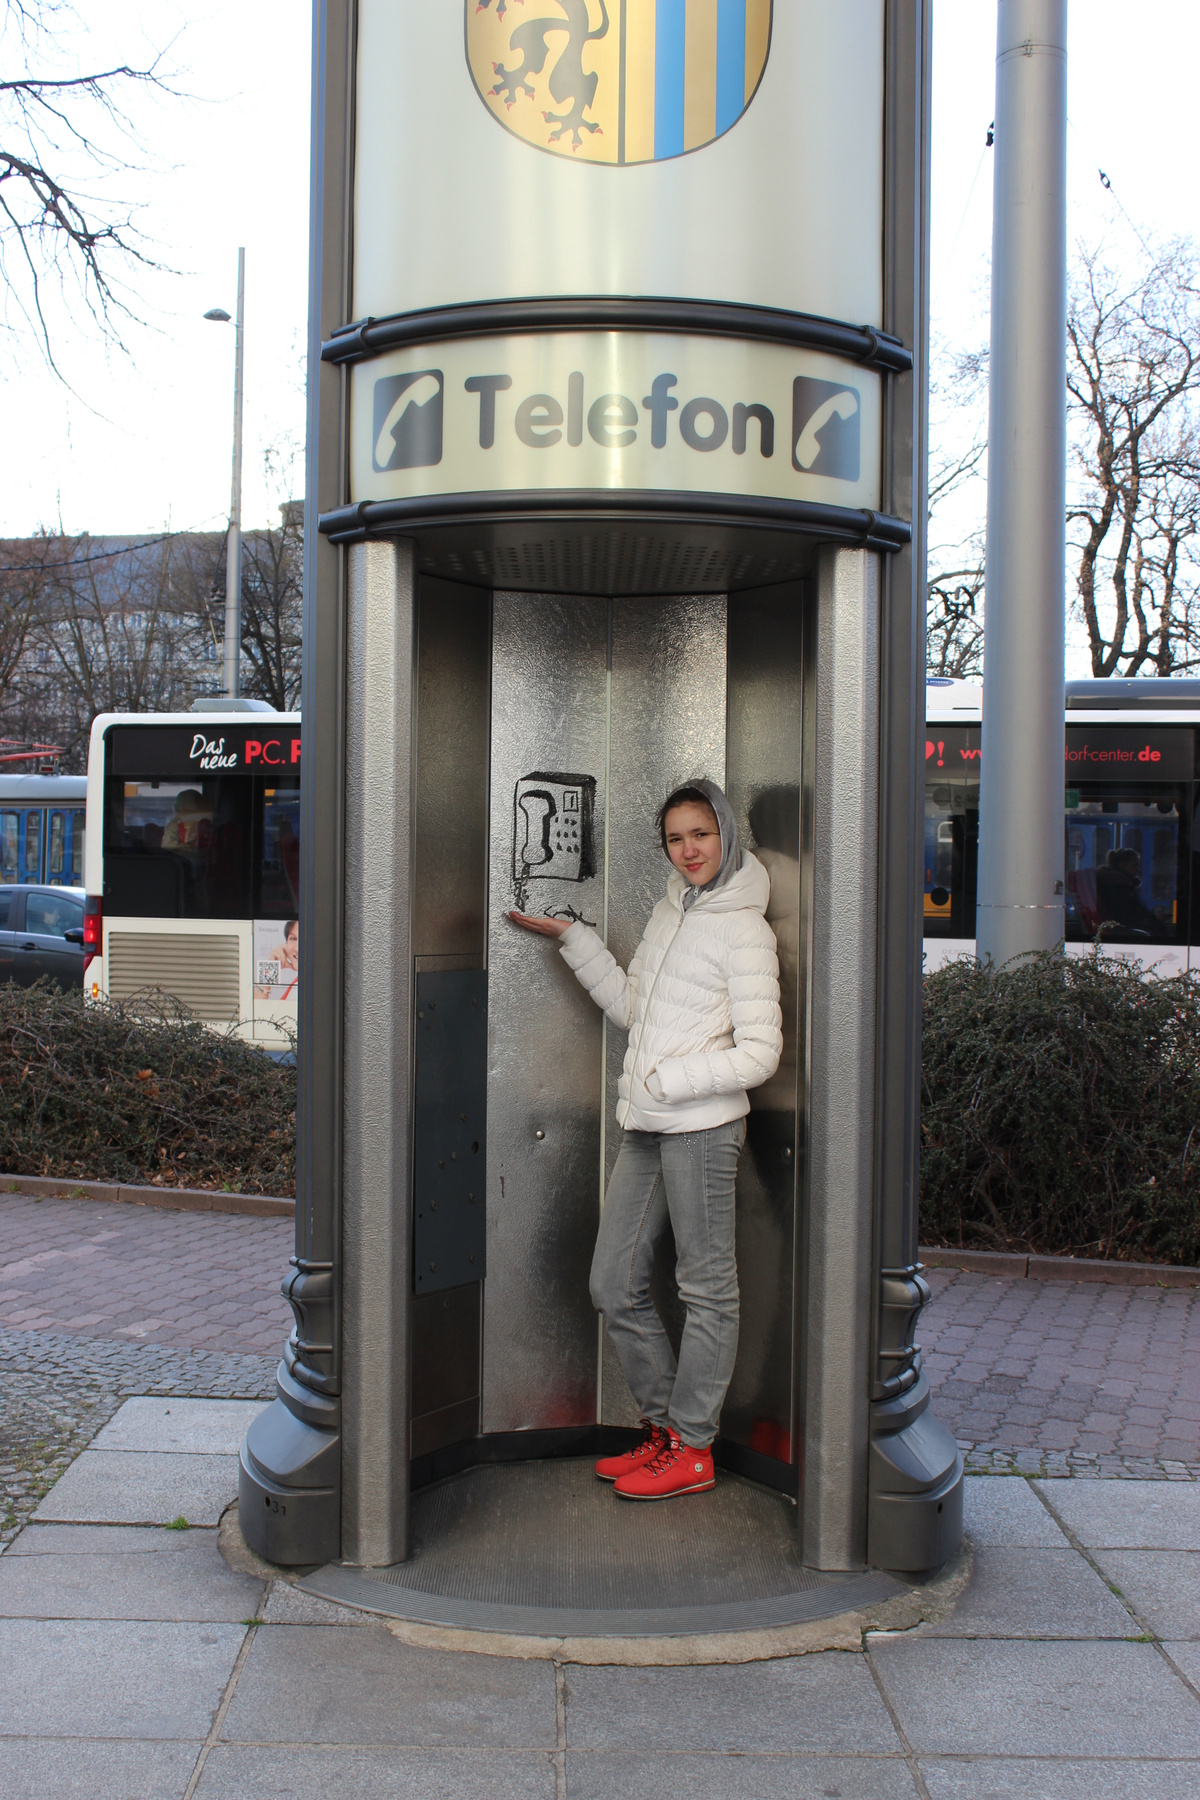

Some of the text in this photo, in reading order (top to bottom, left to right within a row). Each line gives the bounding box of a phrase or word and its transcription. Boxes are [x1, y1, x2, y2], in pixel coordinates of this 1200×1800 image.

[464, 371, 774, 458] Telefon
[189, 734, 225, 759] Das
[200, 753, 237, 769] neue
[272, 1500, 286, 1516] 31
